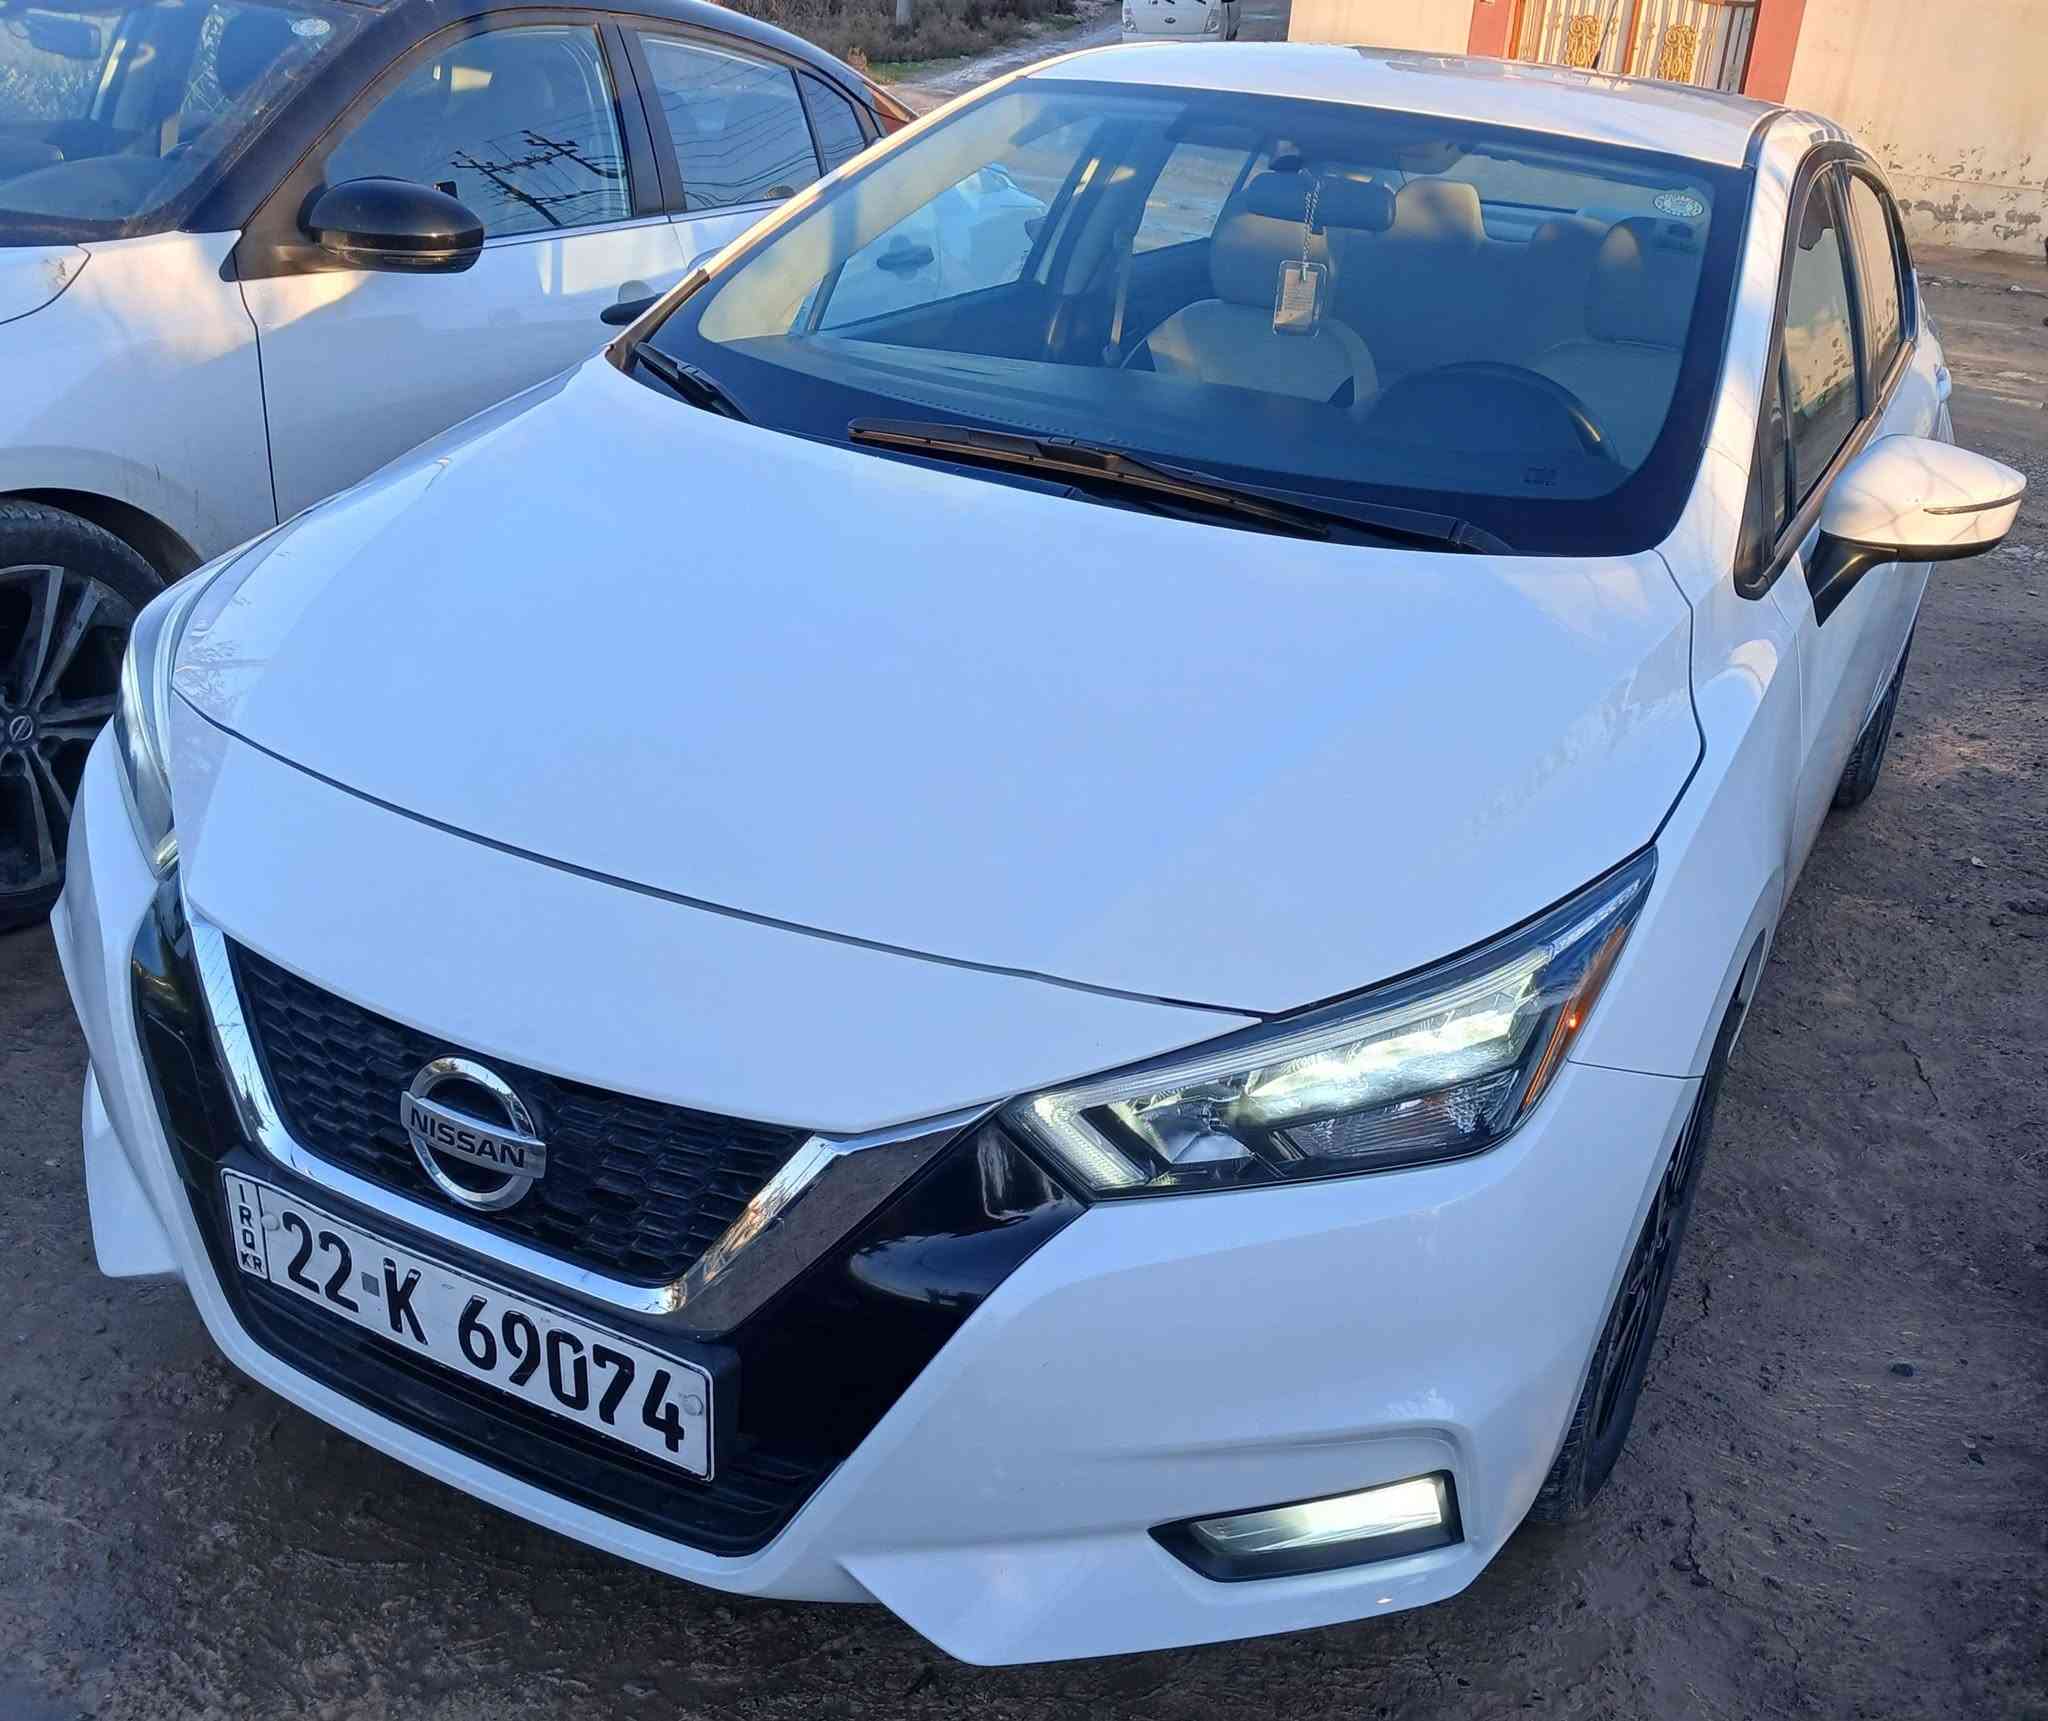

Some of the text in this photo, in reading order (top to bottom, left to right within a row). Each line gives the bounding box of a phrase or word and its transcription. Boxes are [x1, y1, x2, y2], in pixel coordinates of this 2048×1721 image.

[411, 1106, 525, 1169] NISSAN
[238, 1183, 256, 1251] IRQ
[240, 1250, 263, 1273] KR
[458, 1294, 685, 1453] 69074
